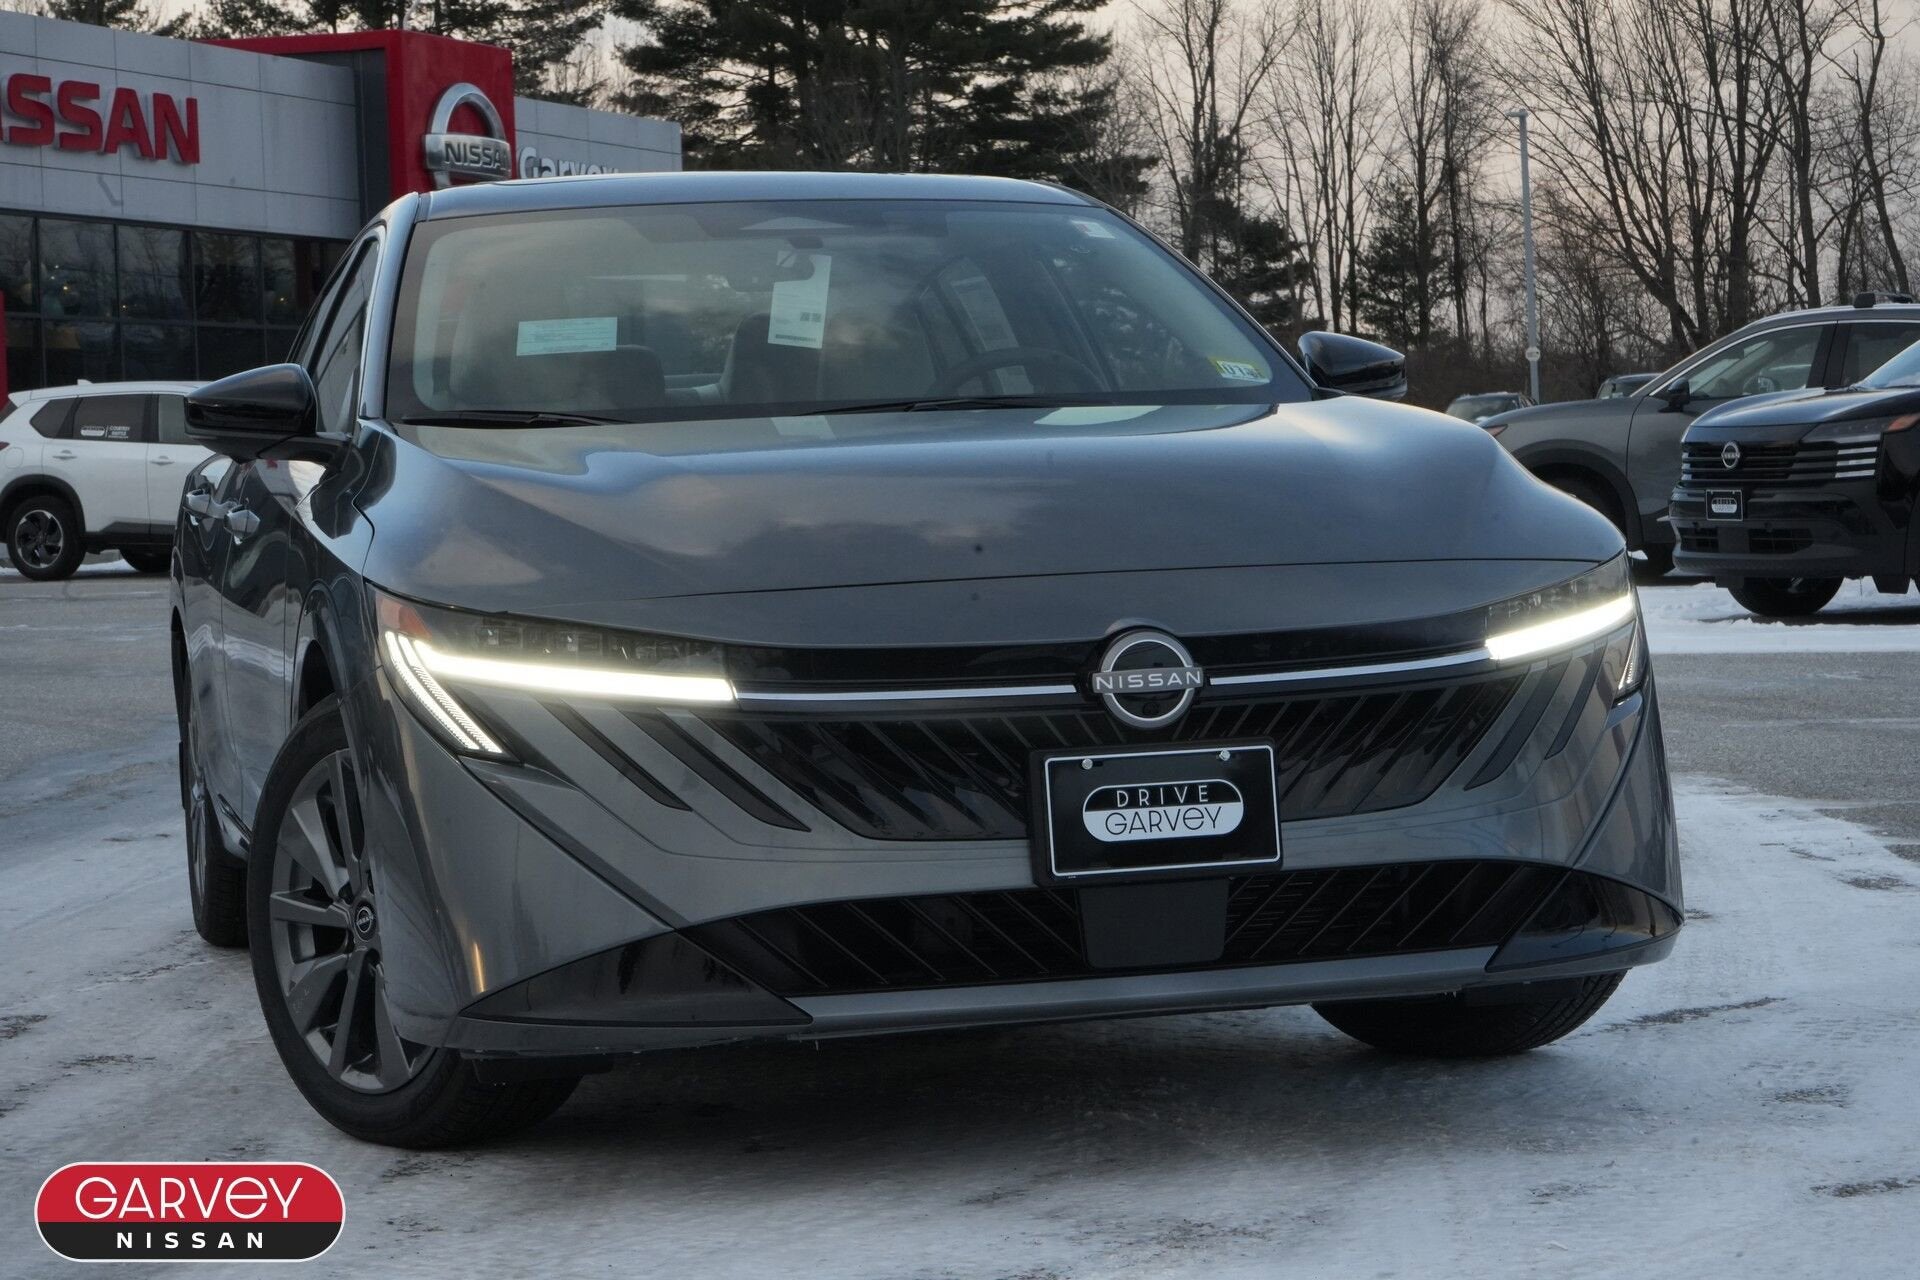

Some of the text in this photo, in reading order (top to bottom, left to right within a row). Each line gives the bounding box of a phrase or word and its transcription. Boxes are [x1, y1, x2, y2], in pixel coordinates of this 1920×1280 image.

[0, 73, 200, 164] SSAN
[444, 141, 509, 171] NISSA
[1095, 671, 1201, 690] NISSAN
[1116, 785, 1209, 808] DRIVE
